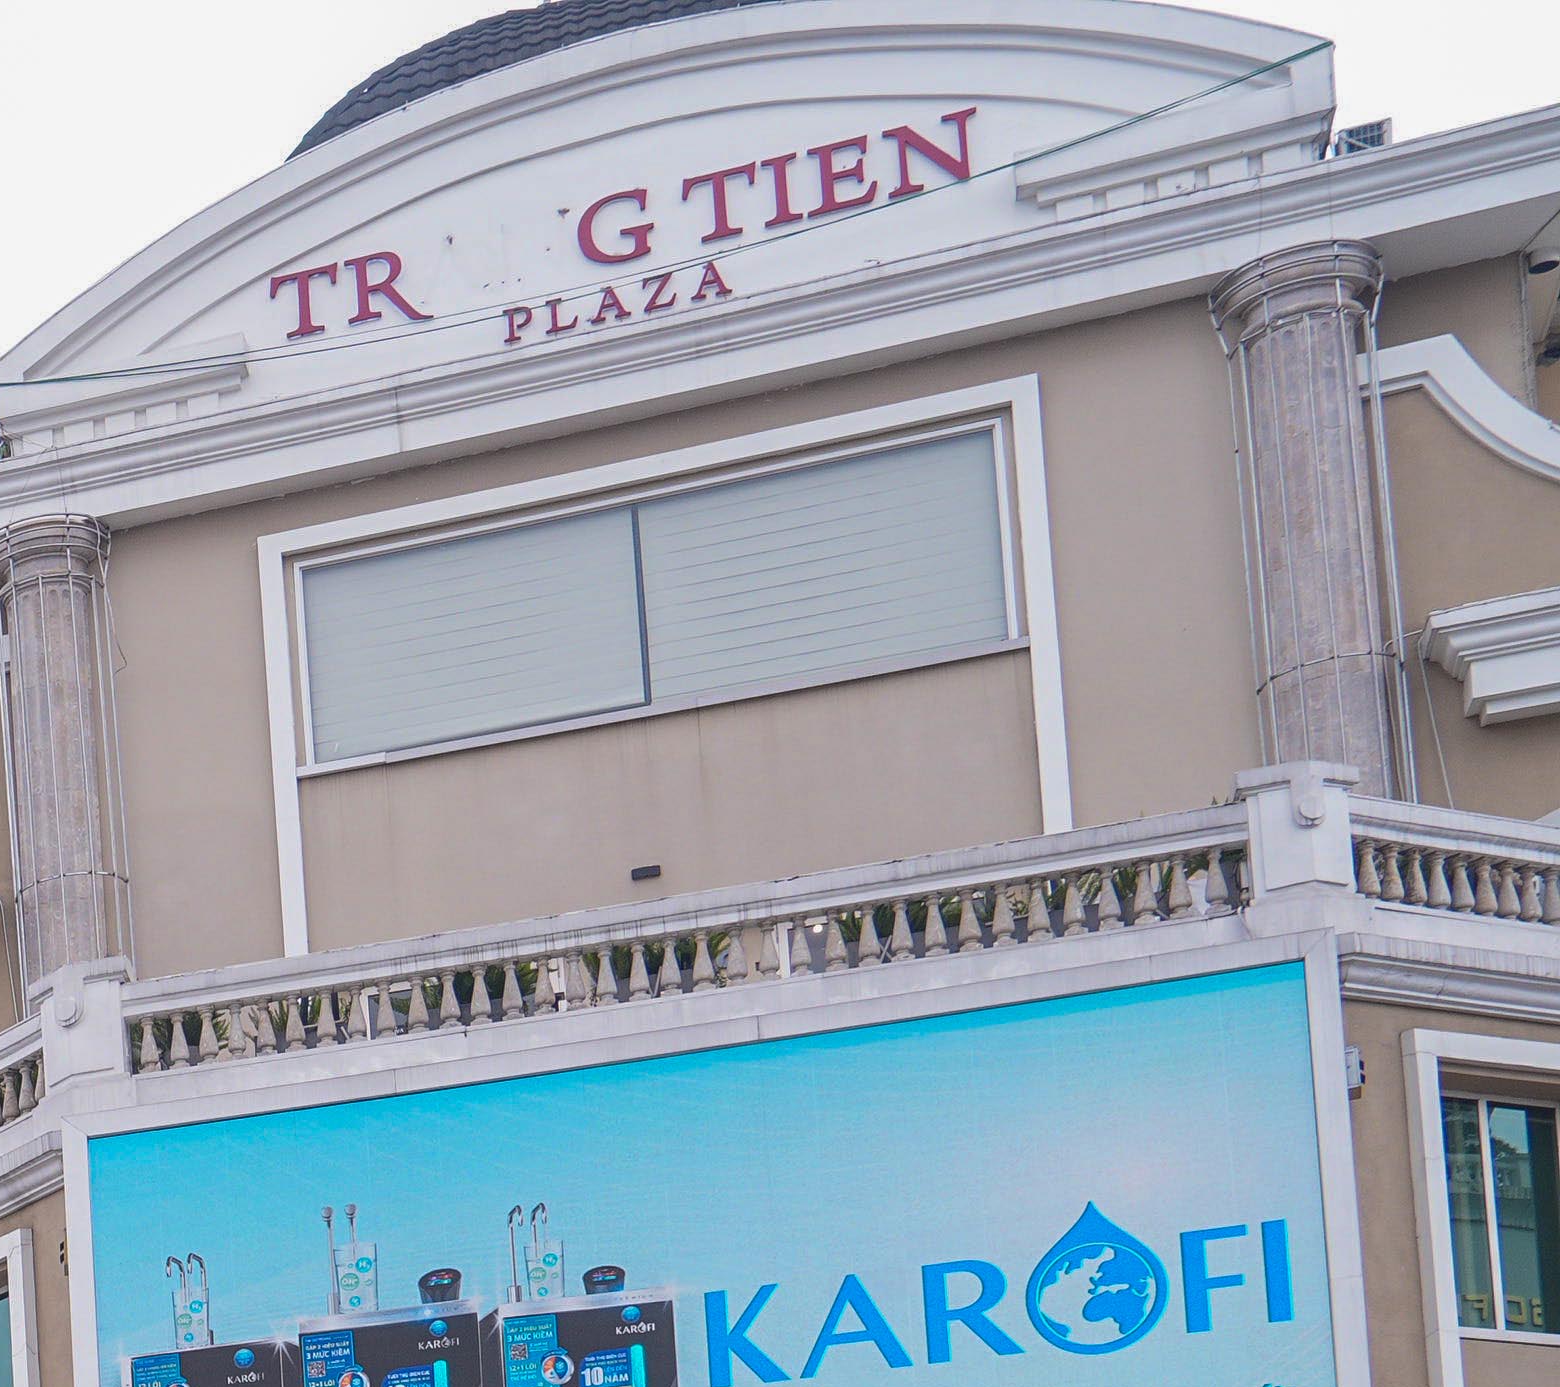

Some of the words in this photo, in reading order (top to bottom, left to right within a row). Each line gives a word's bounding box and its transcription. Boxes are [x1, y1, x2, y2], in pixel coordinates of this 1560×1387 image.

[681, 106, 978, 245] TIEN
[502, 261, 734, 344] PLAZA
[615, 1321, 656, 1335] KAROFI
[581, 1367, 603, 1386] 10
